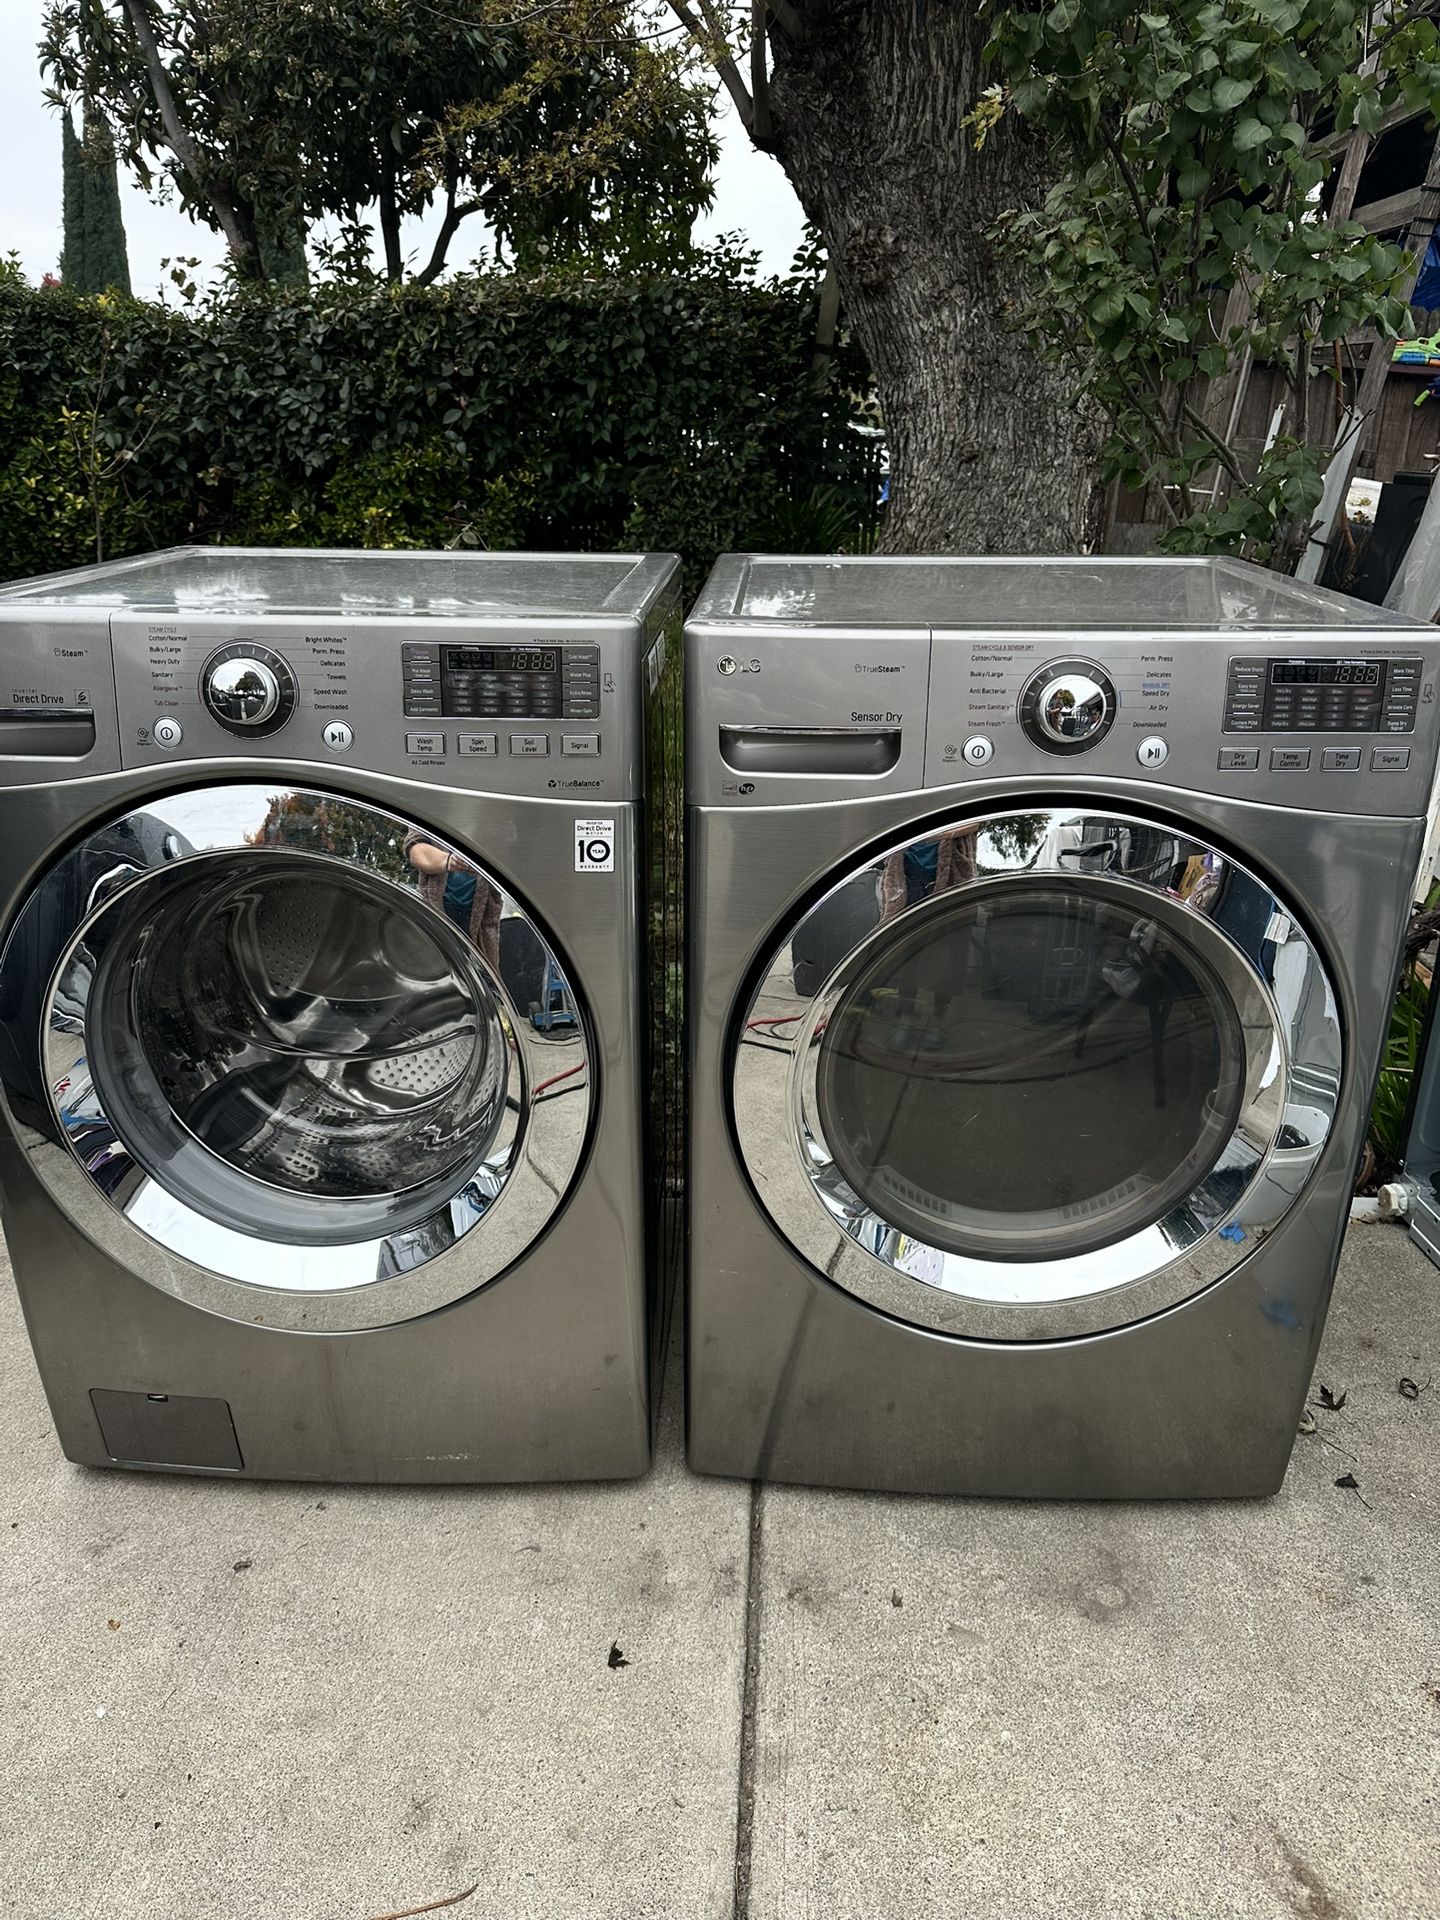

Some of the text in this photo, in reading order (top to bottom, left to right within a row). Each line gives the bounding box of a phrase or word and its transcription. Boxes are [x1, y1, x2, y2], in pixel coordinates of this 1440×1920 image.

[740, 658, 760, 672] LG
[13, 694, 64, 704] Direct Drive
[851, 711, 903, 724] Sensor Dry
[1234, 752, 1245, 761] Dry
[1283, 753, 1298, 761] Temp
[578, 839, 610, 862] 10
